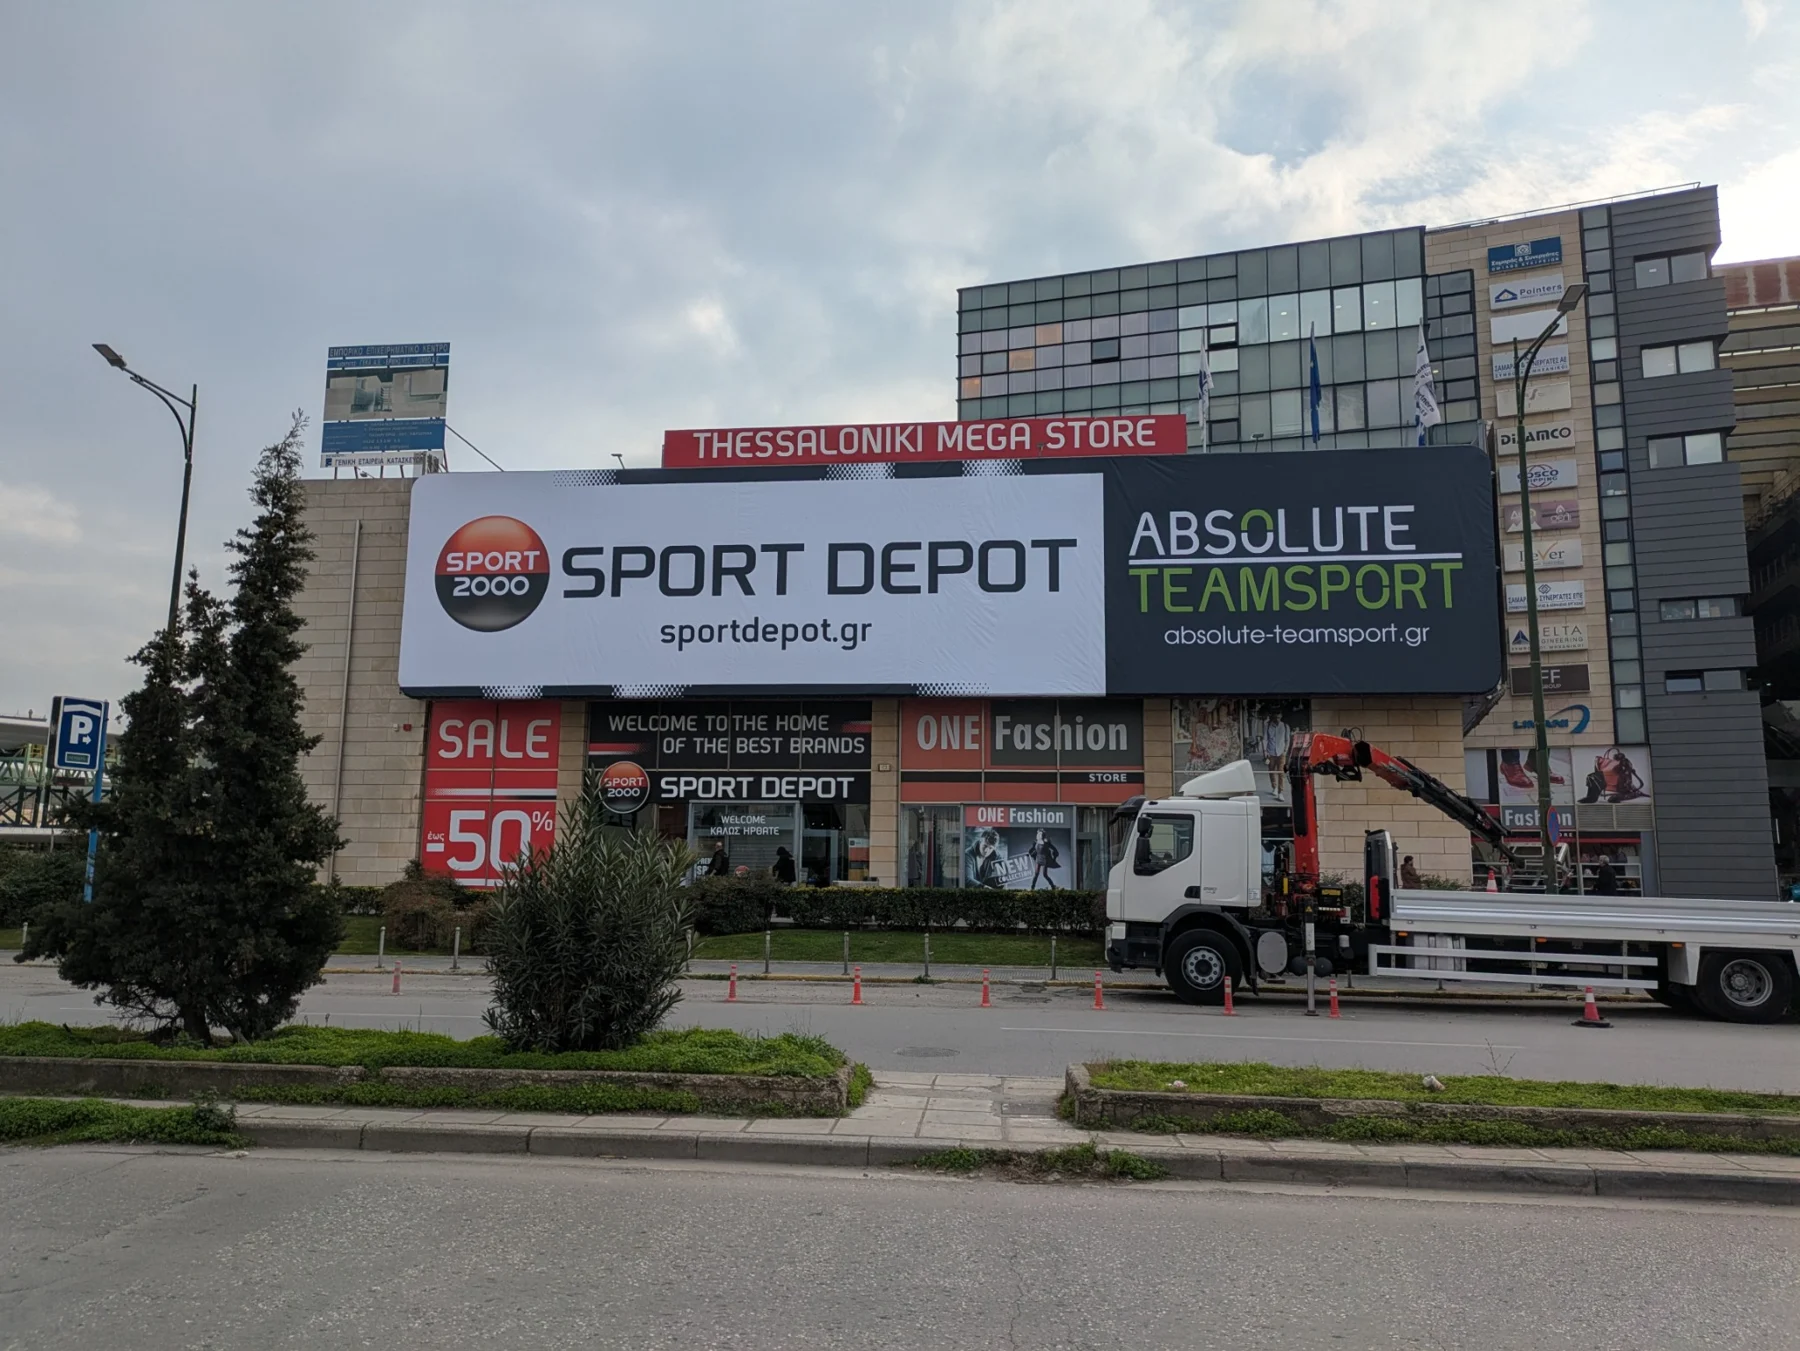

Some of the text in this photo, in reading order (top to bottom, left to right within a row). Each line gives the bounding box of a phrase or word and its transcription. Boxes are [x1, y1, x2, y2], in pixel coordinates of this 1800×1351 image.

[1520, 284, 1562, 296] Pointers
[422, 343, 448, 353] ΚΕΝΤΡΟ
[1495, 363, 1516, 372] ΣΑΜΑΡ
[1527, 357, 1559, 367] ΝΕΡΓΑΤΕΣ
[694, 418, 1157, 459] THESSALONIKI MEGA STORE
[1501, 427, 1571, 445] DiAMCO
[1128, 504, 1417, 556] ABSOLUTE
[446, 550, 540, 573] SPORT
[562, 538, 1077, 599] SPORT DEPOT
[453, 575, 530, 597] 2000
[1128, 562, 1463, 613] TEAMSPORT
[1508, 596, 1527, 604] ΣΑΜΑΡ
[660, 617, 872, 652] sportdepot.gr
[1164, 623, 1430, 647] absolute-teamsport.gr
[1543, 625, 1582, 637] ELTA
[1541, 636, 1583, 644] GINEERING
[69, 714, 93, 745] P
[608, 715, 829, 732] WELCOME TO THE HOME
[438, 719, 551, 758] SALE
[917, 715, 1128, 751] ONE Fashion
[663, 737, 865, 754] OF THE BEST BRANDS
[604, 777, 644, 788] SPORT
[1089, 773, 1127, 782] STORE
[607, 788, 640, 798] 2000
[660, 776, 855, 799] SPORT DEPOT
[721, 815, 766, 824] WELCOME
[978, 807, 1064, 824] ONE Fashion
[1505, 809, 1572, 826] Fashn
[427, 831, 445, 841] έως
[710, 826, 780, 836] ΚΑΛΩΣ ΗΡΘΑΤΕ
[995, 855, 1030, 876] NEW
[998, 870, 1032, 883] COLLECTION
